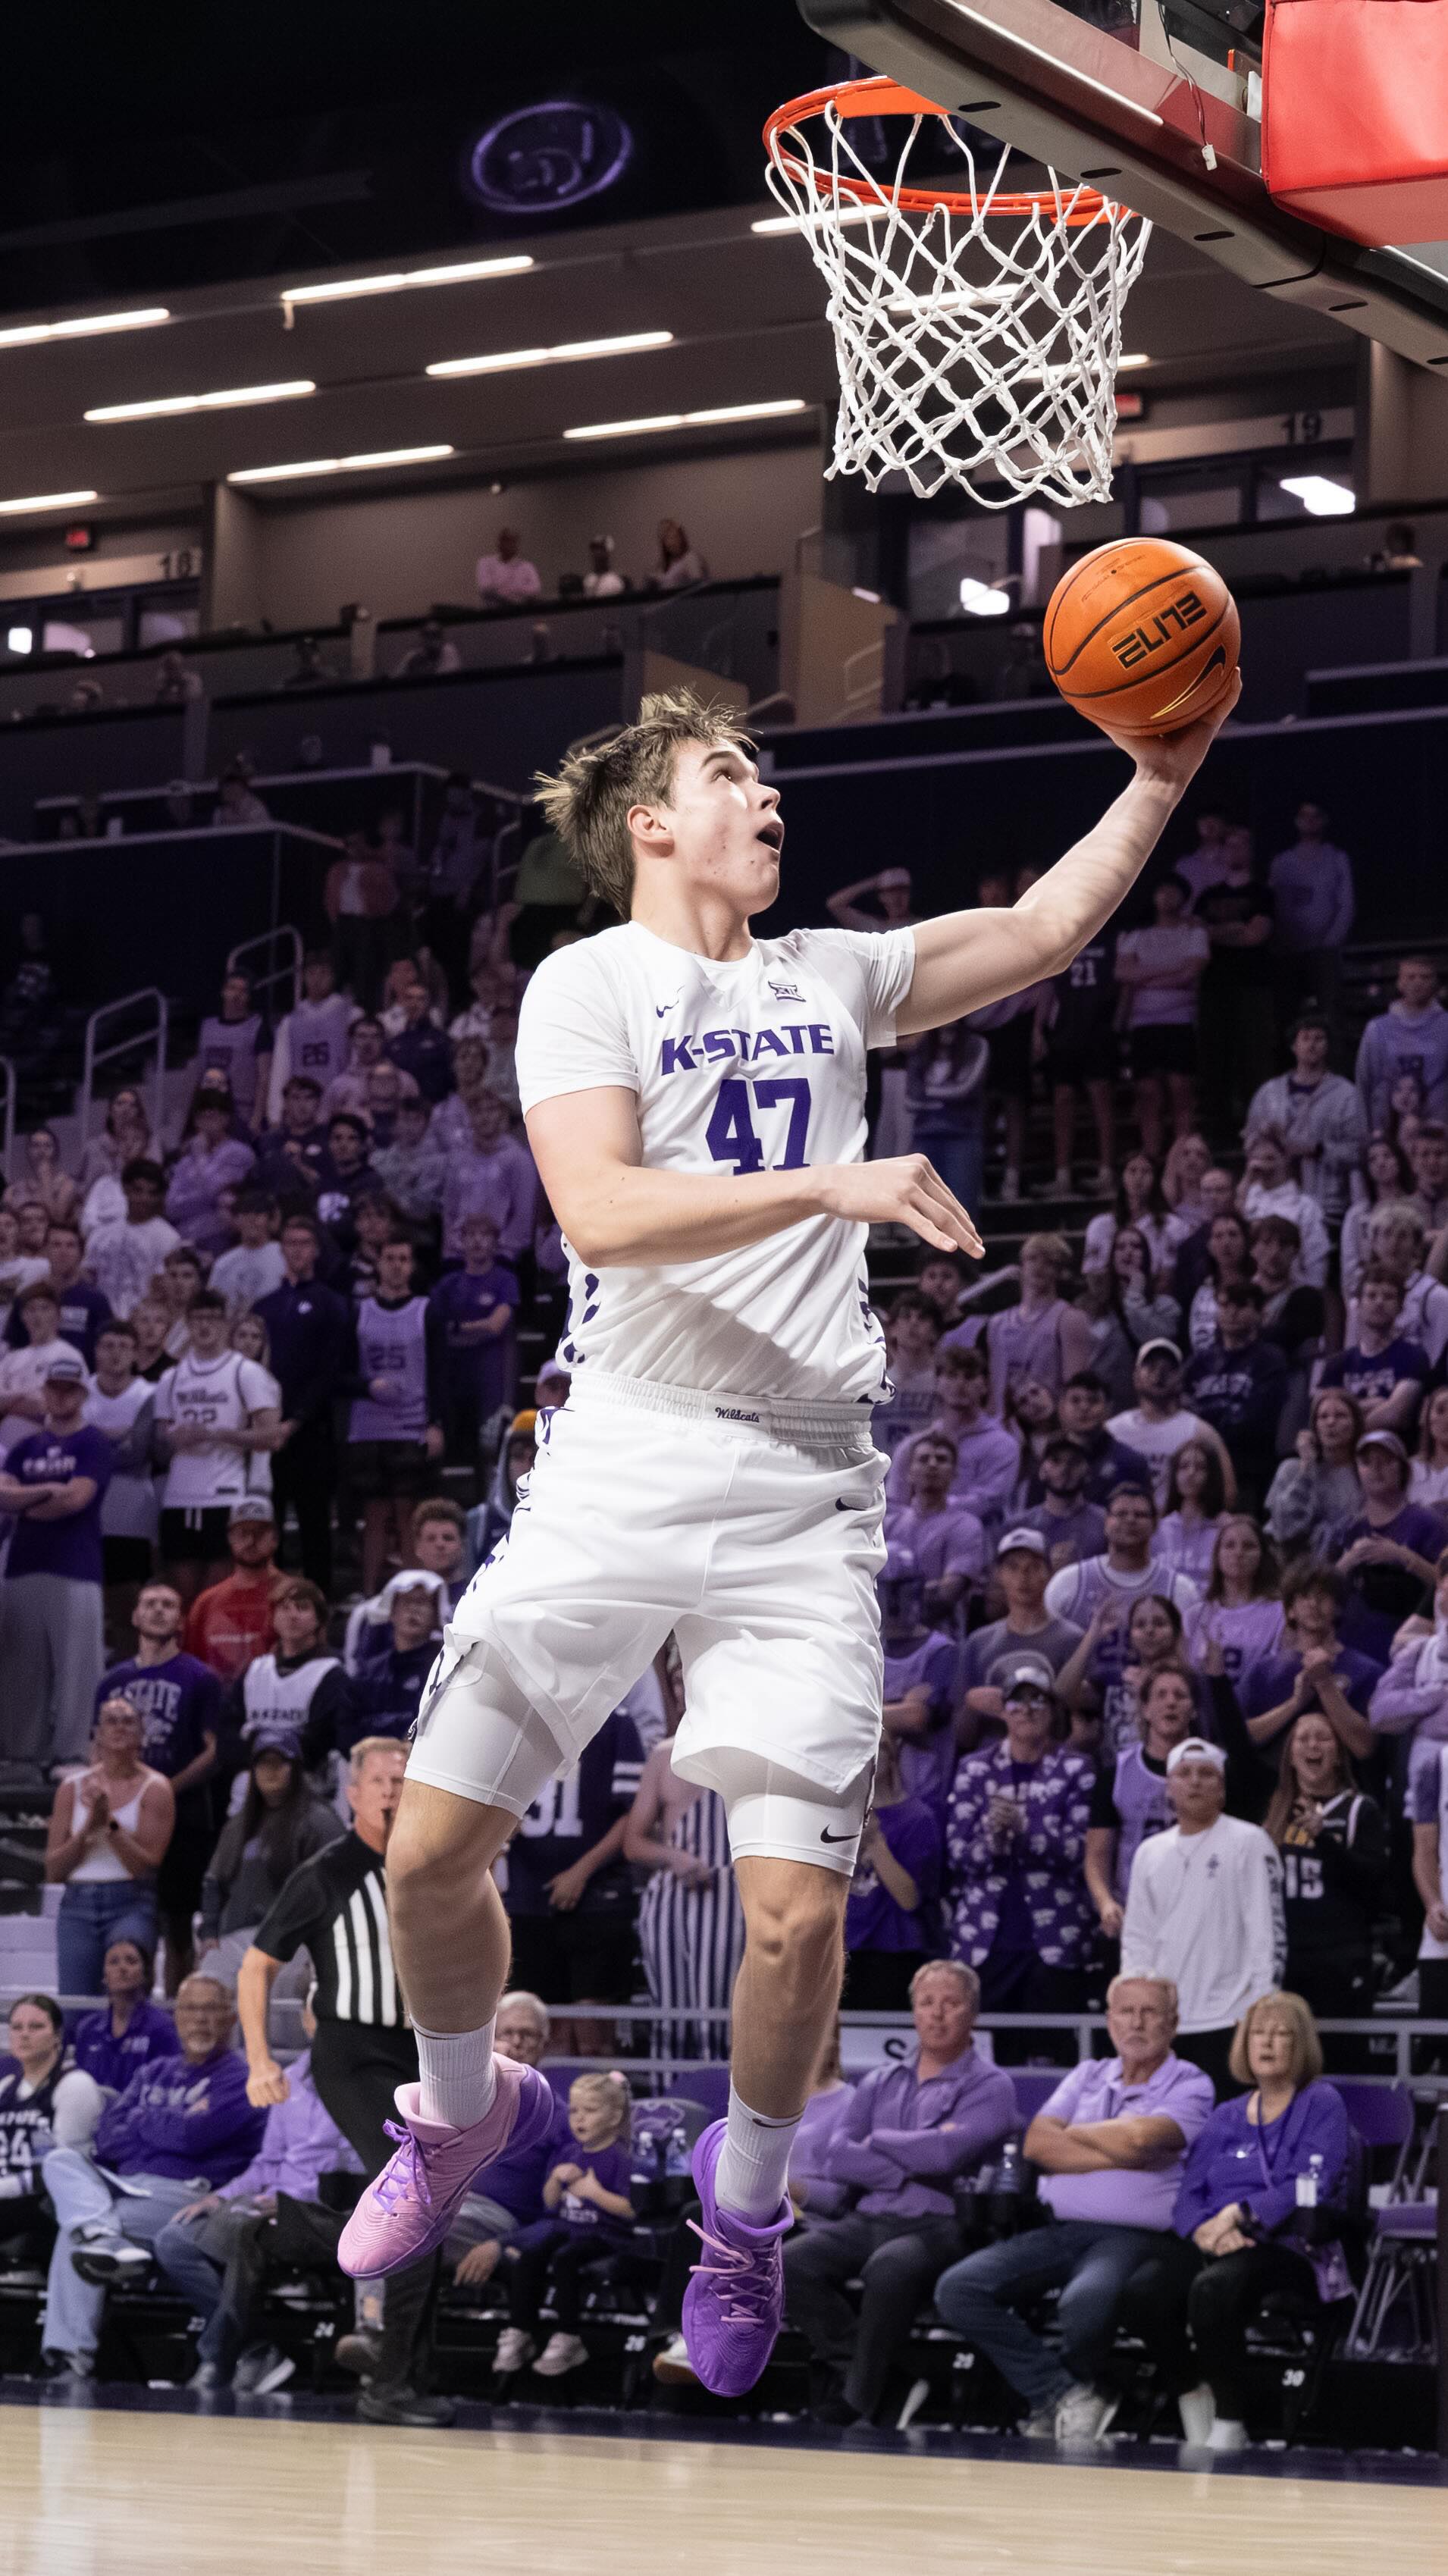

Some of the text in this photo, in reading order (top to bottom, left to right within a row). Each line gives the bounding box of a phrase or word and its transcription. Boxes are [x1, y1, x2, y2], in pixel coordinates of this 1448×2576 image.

[1110, 590, 1208, 669] ELITE
[661, 1024, 835, 1076] K-STATE
[705, 1077, 812, 1176] 47
[715, 1407, 760, 1423] Wildcats
[1285, 1854, 1324, 1898] 15
